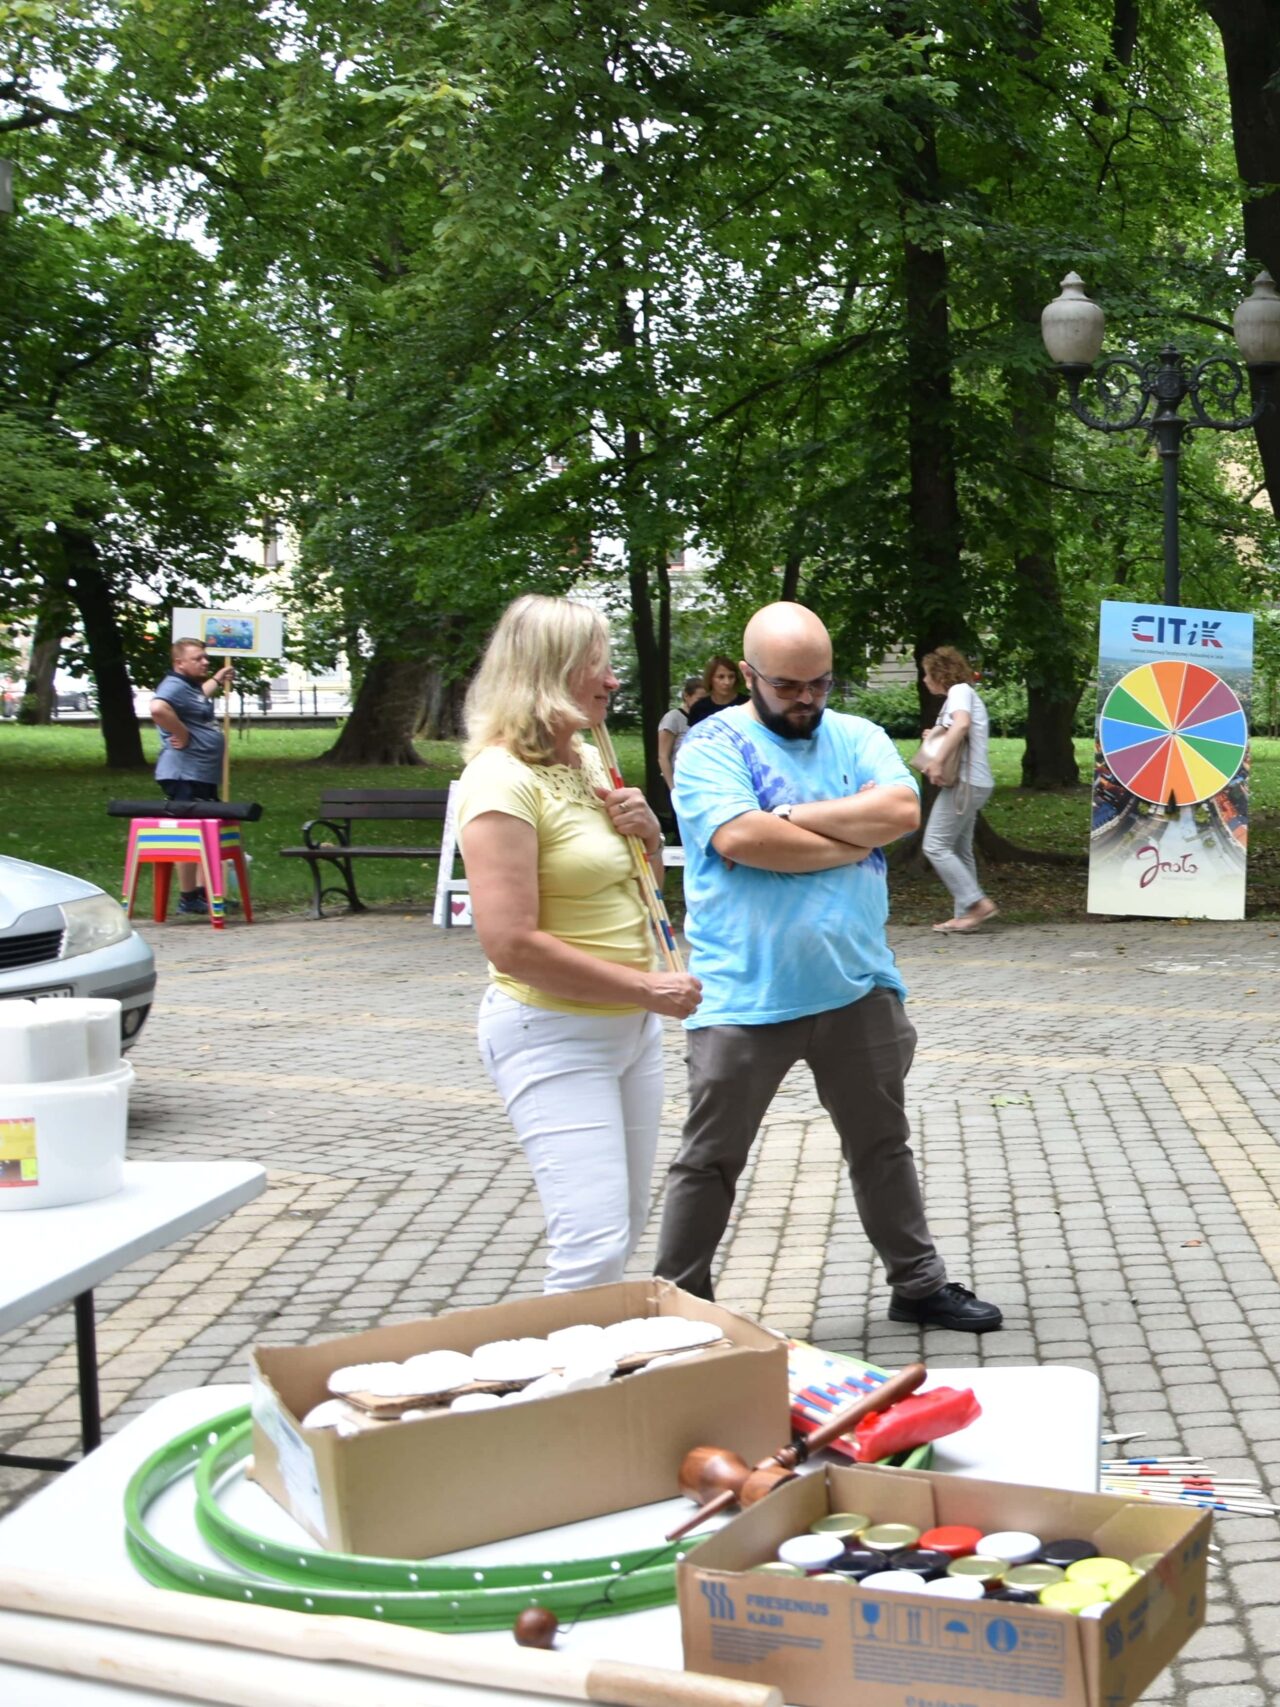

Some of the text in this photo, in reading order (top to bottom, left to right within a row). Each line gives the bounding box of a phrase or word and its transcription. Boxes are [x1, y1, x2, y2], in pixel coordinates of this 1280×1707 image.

[1131, 615, 1223, 648] CITiK
[746, 1594, 829, 1616] FRESENIUS
[747, 1611, 784, 1627] KABI
